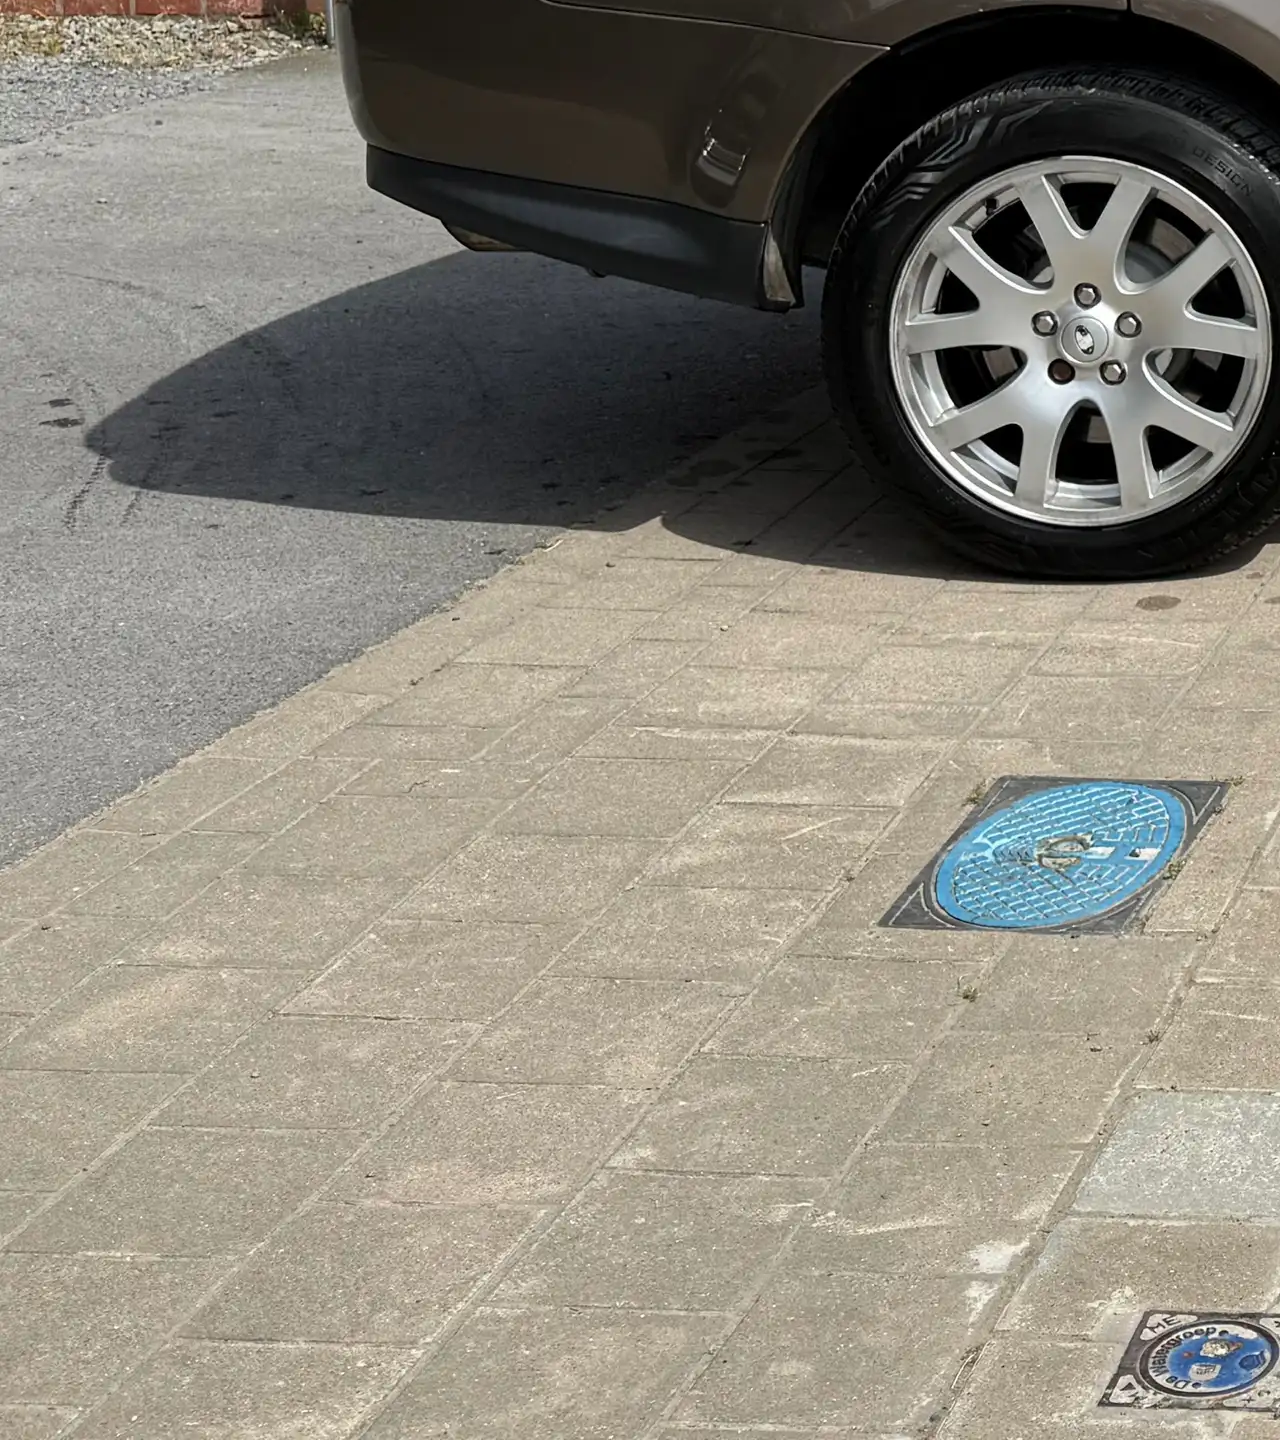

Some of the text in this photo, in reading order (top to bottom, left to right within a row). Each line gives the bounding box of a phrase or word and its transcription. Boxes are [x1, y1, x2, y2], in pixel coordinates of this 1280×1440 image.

[1192, 145, 1254, 197] DESIGN
[1147, 1314, 1182, 1334] ME
[1149, 1326, 1217, 1378] Watergroep
[1166, 1375, 1191, 1390] De
